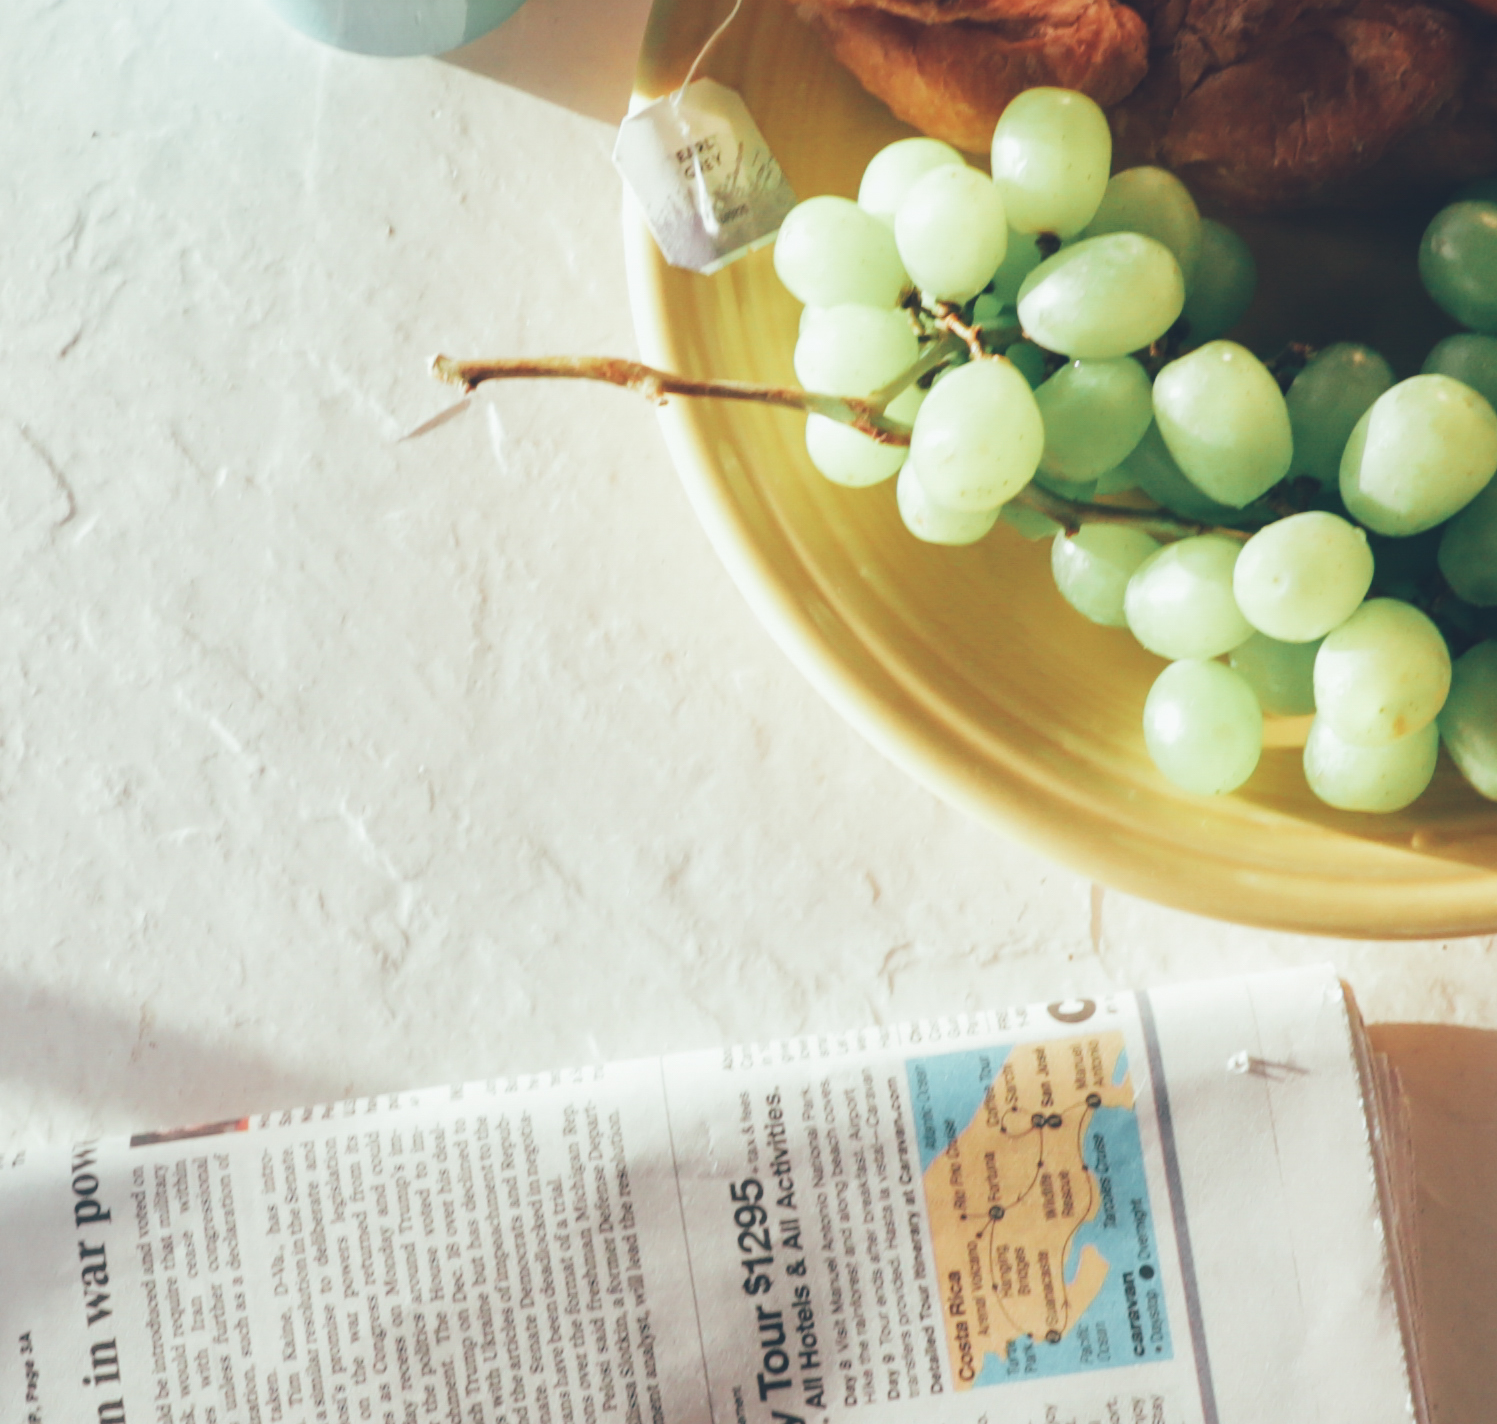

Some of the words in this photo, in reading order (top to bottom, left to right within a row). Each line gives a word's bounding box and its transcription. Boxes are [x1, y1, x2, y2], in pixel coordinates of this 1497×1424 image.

[913, 1064, 930, 1100] Ocean
[977, 1054, 992, 1081] Tour
[1070, 1044, 1088, 1089] Manuel
[1087, 1040, 1105, 1086] Antonio
[800, 1085, 815, 1121] Park.
[820, 1077, 836, 1124] coves.
[843, 1088, 863, 1142] Airport
[981, 1085, 999, 1126] Coffee
[1038, 1081, 1053, 1107] San
[429, 1123, 448, 1163] deal-
[764, 1087, 797, 1210] Activities.
[887, 1077, 913, 1186] Caravan.com
[919, 1104, 937, 1150] Atlantic
[942, 1118, 960, 1159] Cruise
[747, 1138, 759, 1163] tax
[806, 1125, 826, 1188] National
[825, 1127, 844, 1178] beach
[1090, 1132, 1108, 1172] Cruise
[71, 1149, 111, 1227] pow
[436, 1167, 452, 1194] his
[568, 1142, 590, 1222] Michigan
[834, 1179, 851, 1223] along
[853, 1146, 874, 1224] breakfast.
[1038, 1173, 1058, 1219] Wildlife
[1057, 1171, 1075, 1217] Rescue
[192, 1156, 220, 1272] congressional
[442, 1199, 457, 1236] over
[729, 1177, 774, 1296] $1295
[779, 1218, 803, 1251] All
[816, 1192, 835, 1252] Antonio
[882, 1203, 898, 1250] Hasta
[1129, 1198, 1151, 1259] Overnight
[840, 1227, 856, 1258] and
[865, 1228, 881, 1264] after
[907, 1211, 926, 1280] Itinerary
[965, 1240, 984, 1291] Volcano
[78, 1240, 112, 1326] war
[451, 1267, 467, 1303] Dec.
[580, 1227, 603, 1312] freshman
[824, 1256, 844, 1314] Manuel
[871, 1267, 887, 1307] ends
[888, 1255, 911, 1326] provided.
[943, 1269, 966, 1316] Rica
[993, 1244, 1016, 1297] Hanging
[1011, 1246, 1033, 1295] Bridges
[208, 1283, 228, 1344] further
[845, 1261, 867, 1336] rainforest
[917, 1284, 932, 1321] Tour
[973, 1295, 991, 1335] Arenal
[1120, 1272, 1146, 1355] caravan
[589, 1316, 609, 1355] said
[791, 1284, 821, 1370] Hotels
[833, 1318, 850, 1352] Visit
[878, 1311, 893, 1346] Tour
[1076, 1323, 1094, 1364] Pacific
[1093, 1321, 1111, 1362] Ocean
[82, 1338, 120, 1386] in
[461, 1335, 481, 1398] Trump
[755, 1304, 793, 1402] Tour
[858, 1339, 871, 1365] the
[900, 1329, 920, 1398] transfers
[922, 1325, 944, 1394] Detailed
[951, 1320, 976, 1381] Costa
[1022, 1343, 1038, 1372] Park
[24, 1359, 40, 1402] Page
[218, 1354, 238, 1412] unless
[596, 1359, 617, 1412] Pelosi
[802, 1376, 826, 1410] All
[843, 1374, 858, 1407] Day
[862, 1368, 876, 1404] Hike
[886, 1369, 901, 1401] Day
